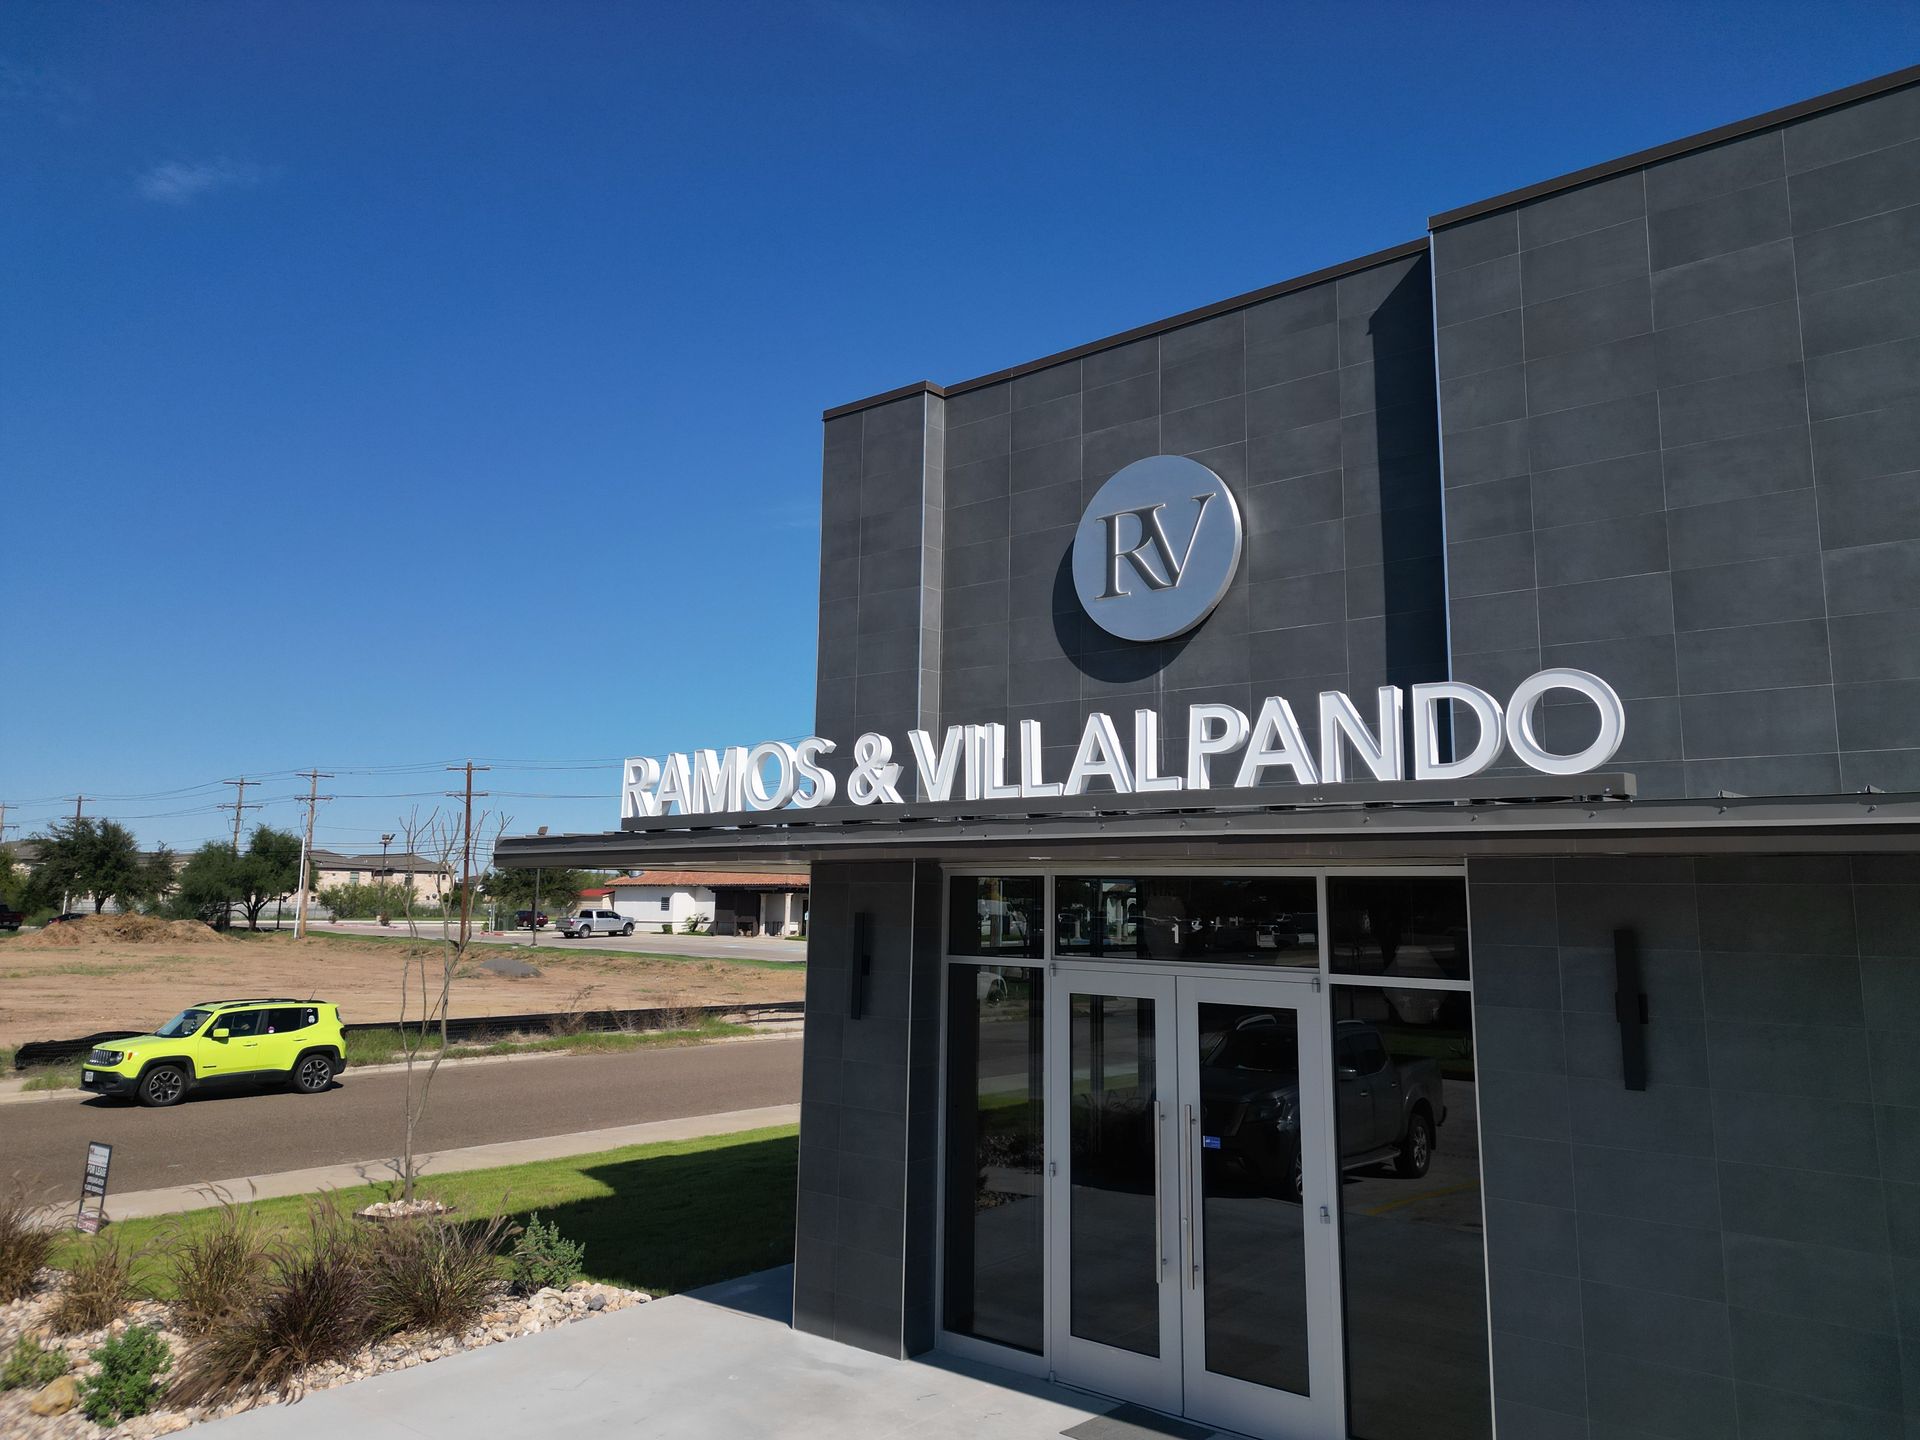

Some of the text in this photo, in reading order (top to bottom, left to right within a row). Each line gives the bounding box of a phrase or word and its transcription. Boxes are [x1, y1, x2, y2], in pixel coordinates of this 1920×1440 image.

[1095, 492, 1216, 600] RV
[621, 667, 1625, 818] RAMOS & VILLALPANDO
